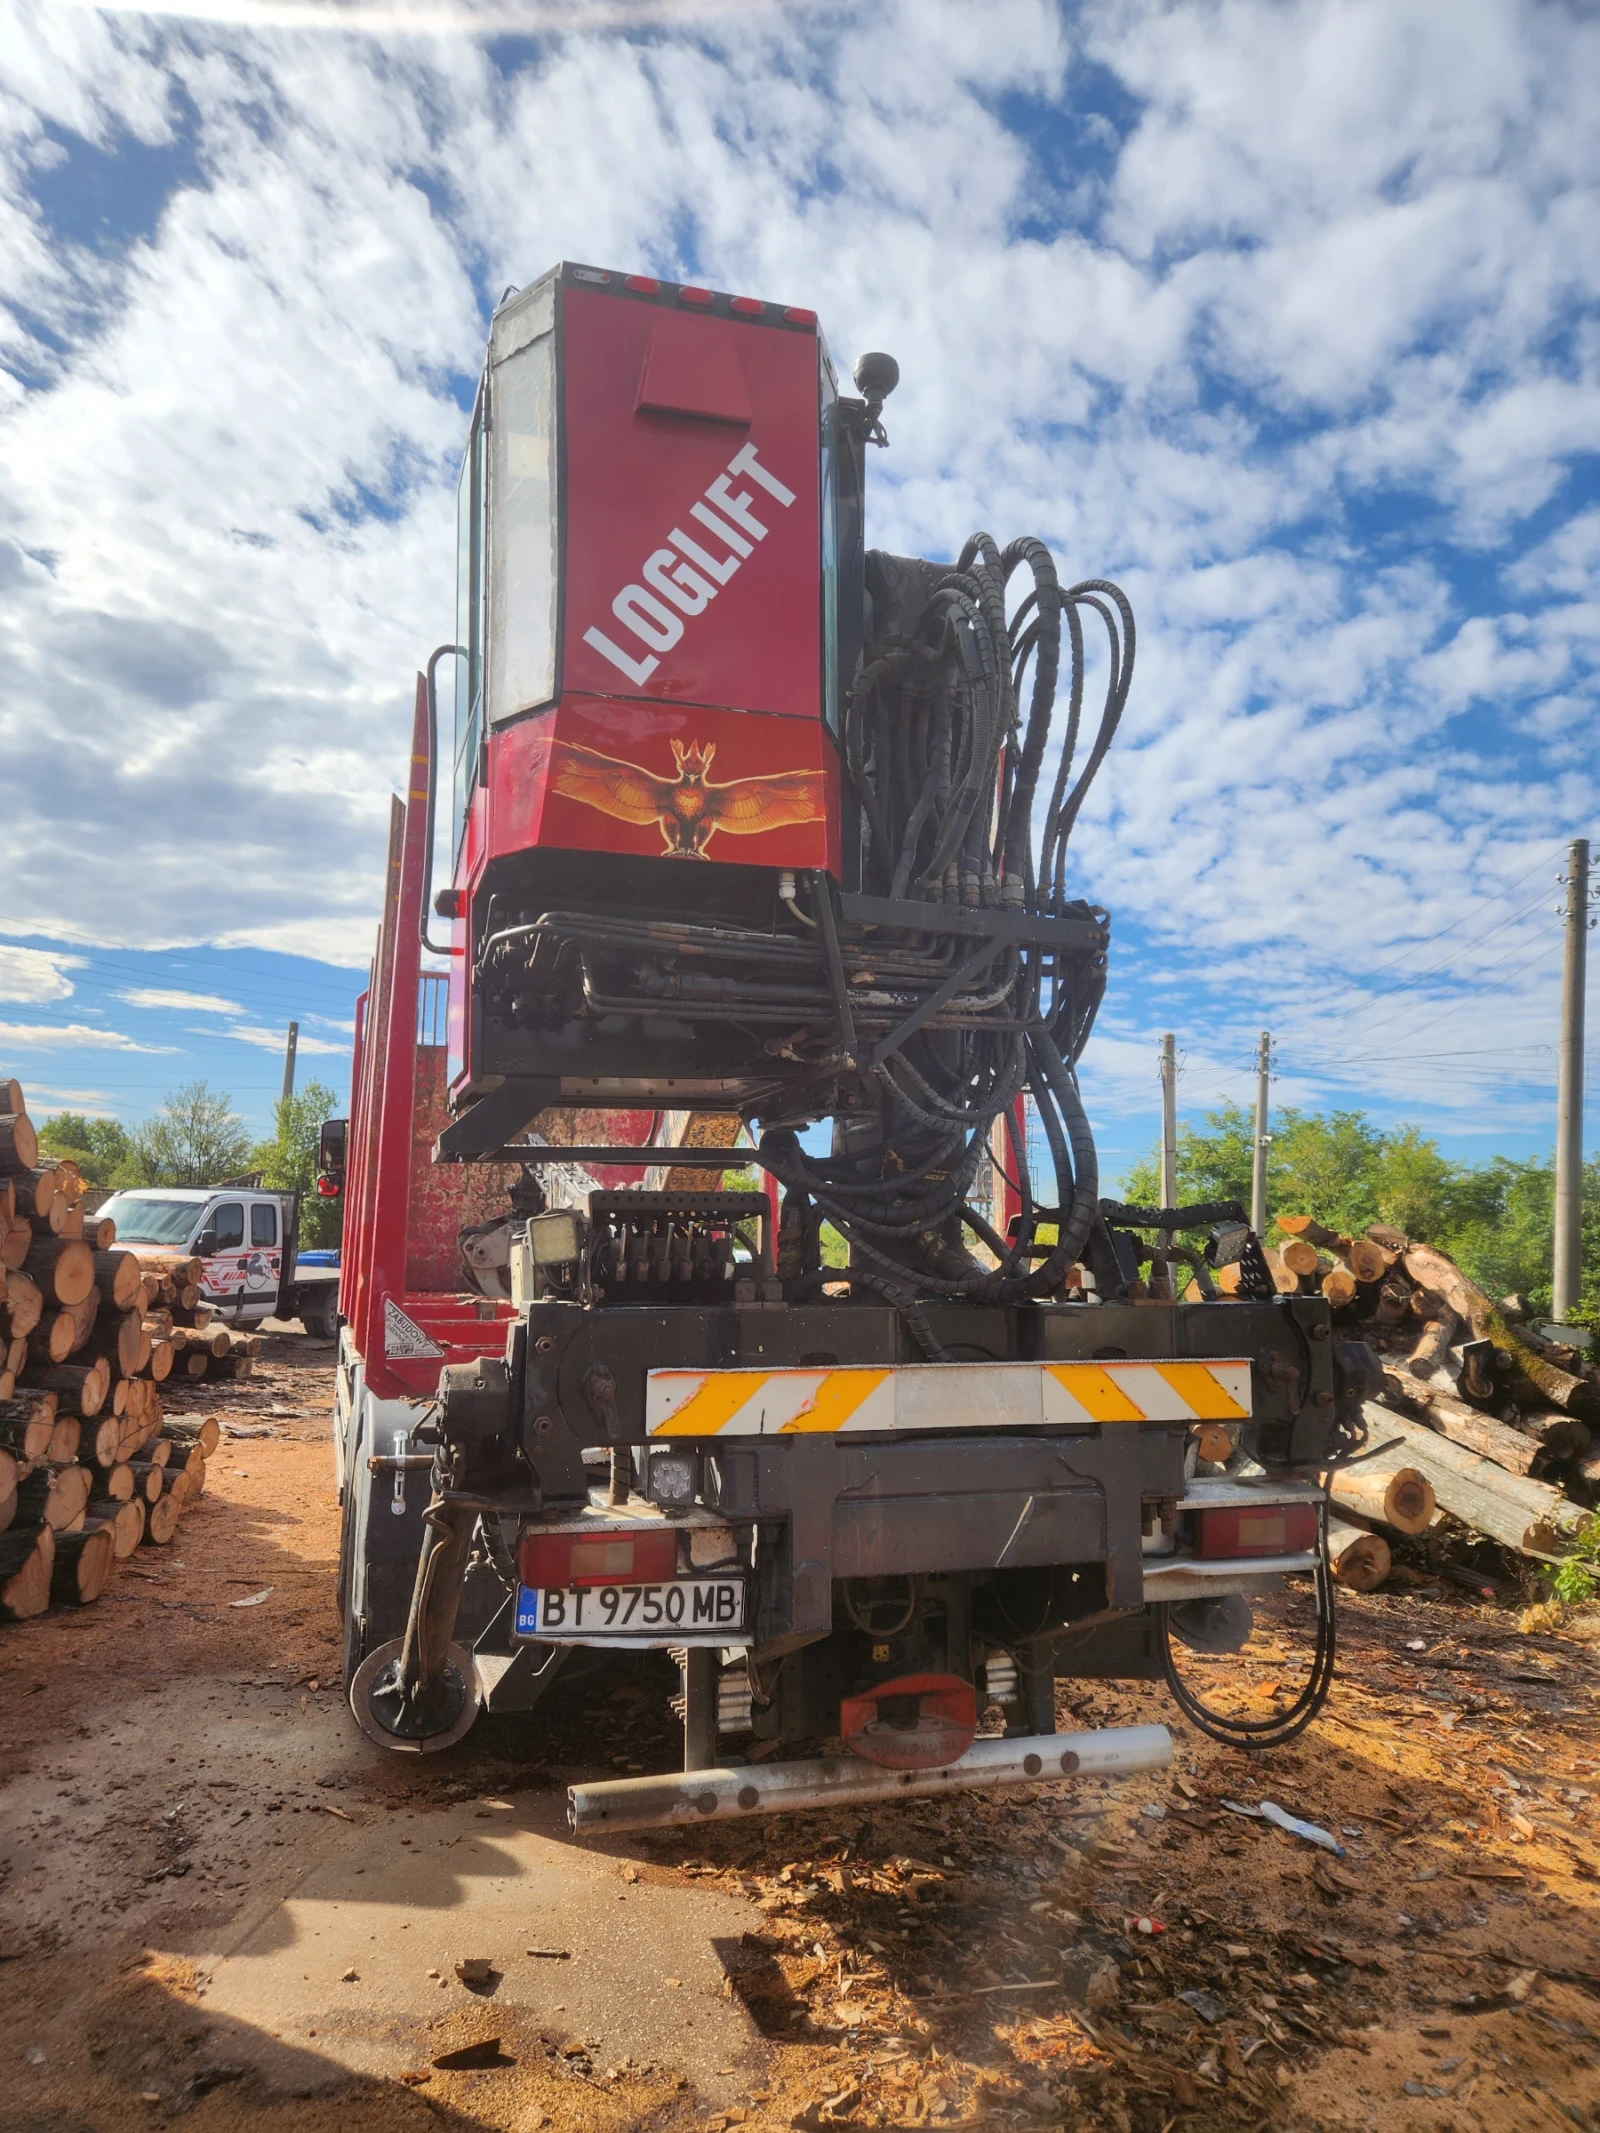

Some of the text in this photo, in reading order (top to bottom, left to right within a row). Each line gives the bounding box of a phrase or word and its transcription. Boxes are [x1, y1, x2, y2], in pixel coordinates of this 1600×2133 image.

[582, 441, 797, 687] LOGLIFT
[388, 1308, 430, 1348] ZABUDOWY
[519, 1614, 535, 1626] BG
[542, 1586, 735, 1626] BT 9750 MB
